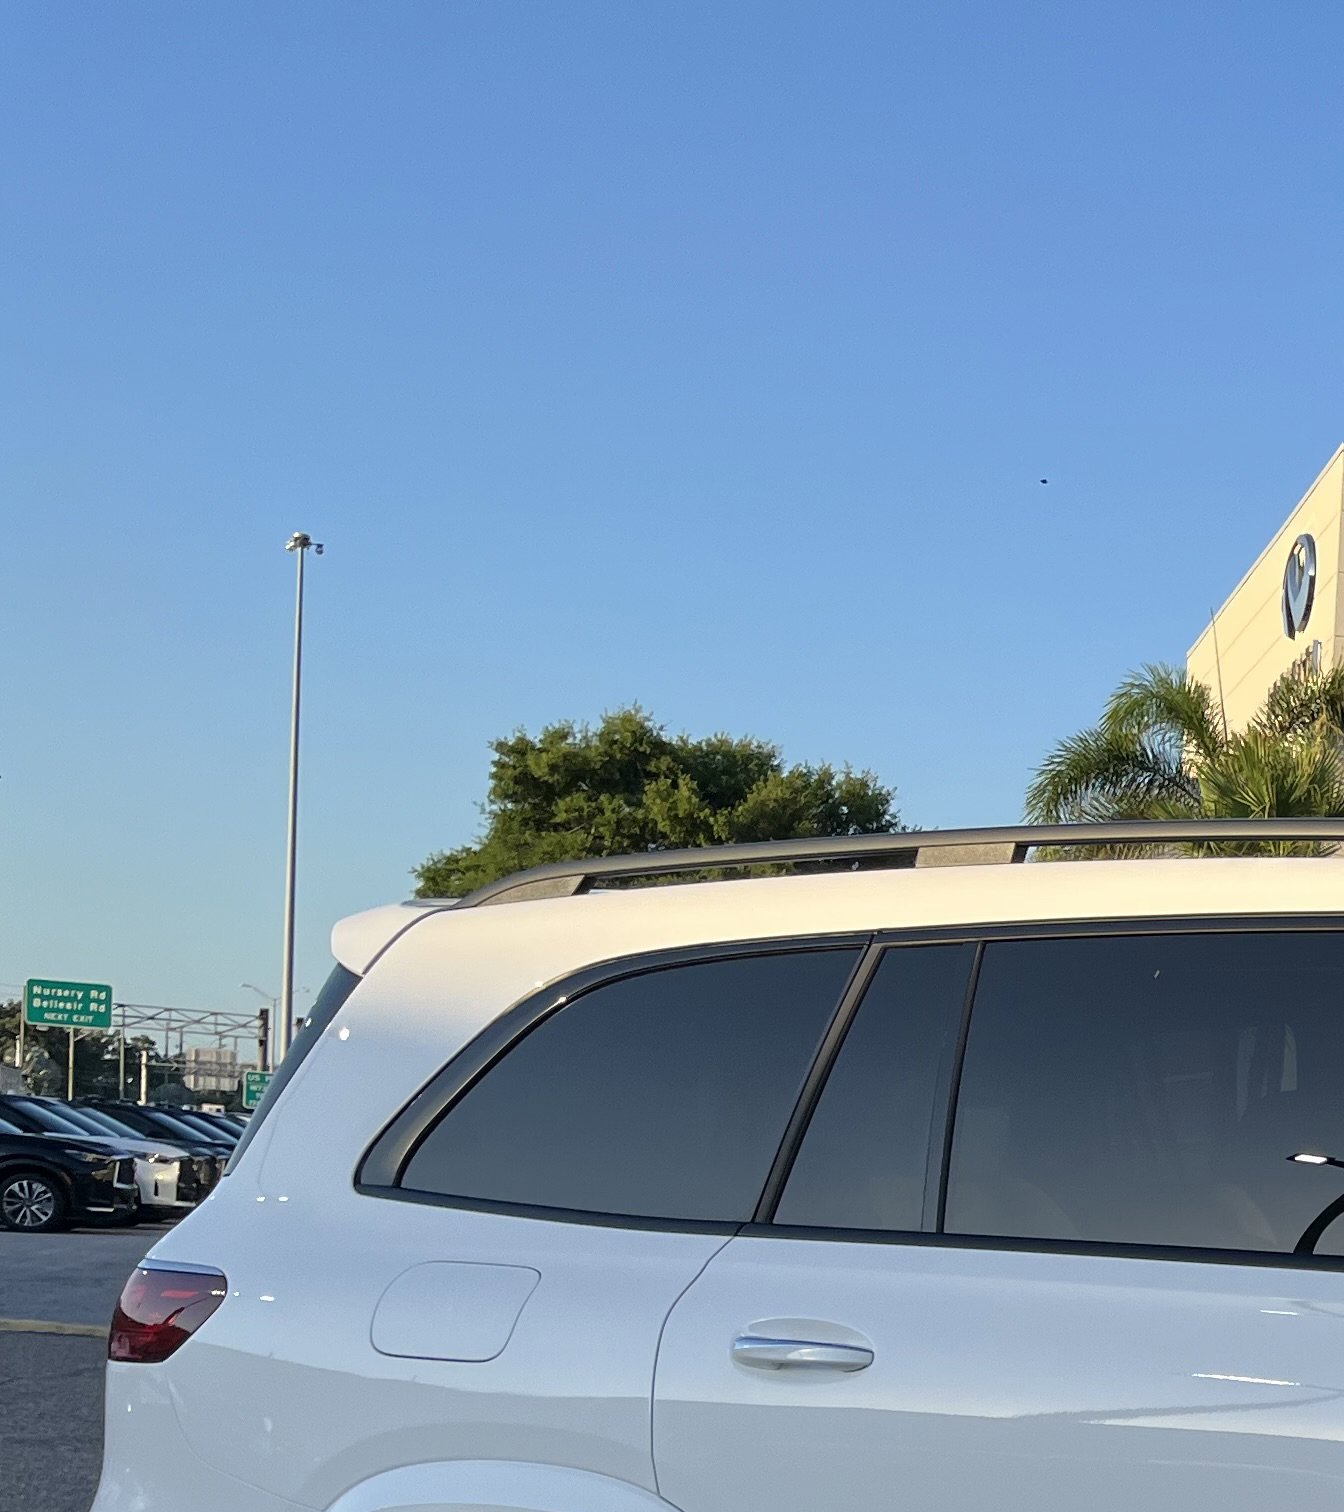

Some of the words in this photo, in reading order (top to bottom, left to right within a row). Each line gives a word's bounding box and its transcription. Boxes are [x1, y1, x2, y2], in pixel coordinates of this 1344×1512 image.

[32, 984, 84, 1000] Nursery
[89, 989, 107, 1001] Rd
[32, 998, 84, 1011] Belleair
[89, 1002, 106, 1013] Rd
[43, 1012, 69, 1021] NEXT
[72, 1014, 95, 1024] EXIT
